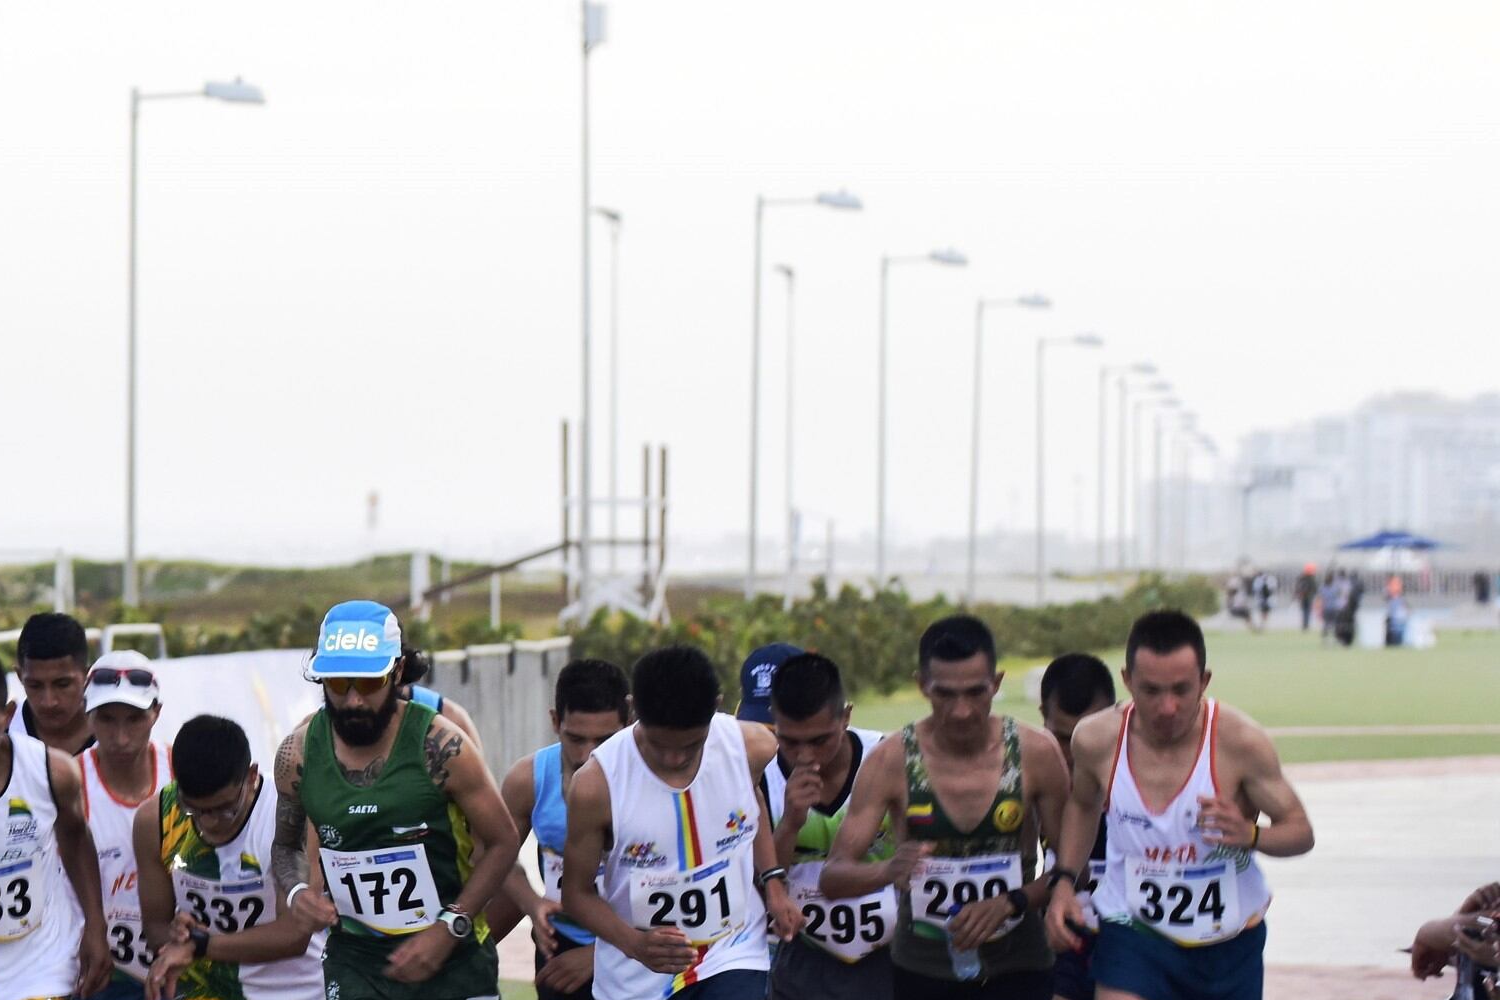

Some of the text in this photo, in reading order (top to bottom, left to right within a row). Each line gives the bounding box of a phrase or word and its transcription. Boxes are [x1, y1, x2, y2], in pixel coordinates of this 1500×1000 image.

[325, 627, 379, 652] ciele
[348, 804, 378, 814] SAETA
[185, 891, 265, 934] 332
[340, 867, 425, 915] 172
[648, 876, 731, 929] 291
[1139, 880, 1226, 928] 324
[802, 901, 885, 944] 295
